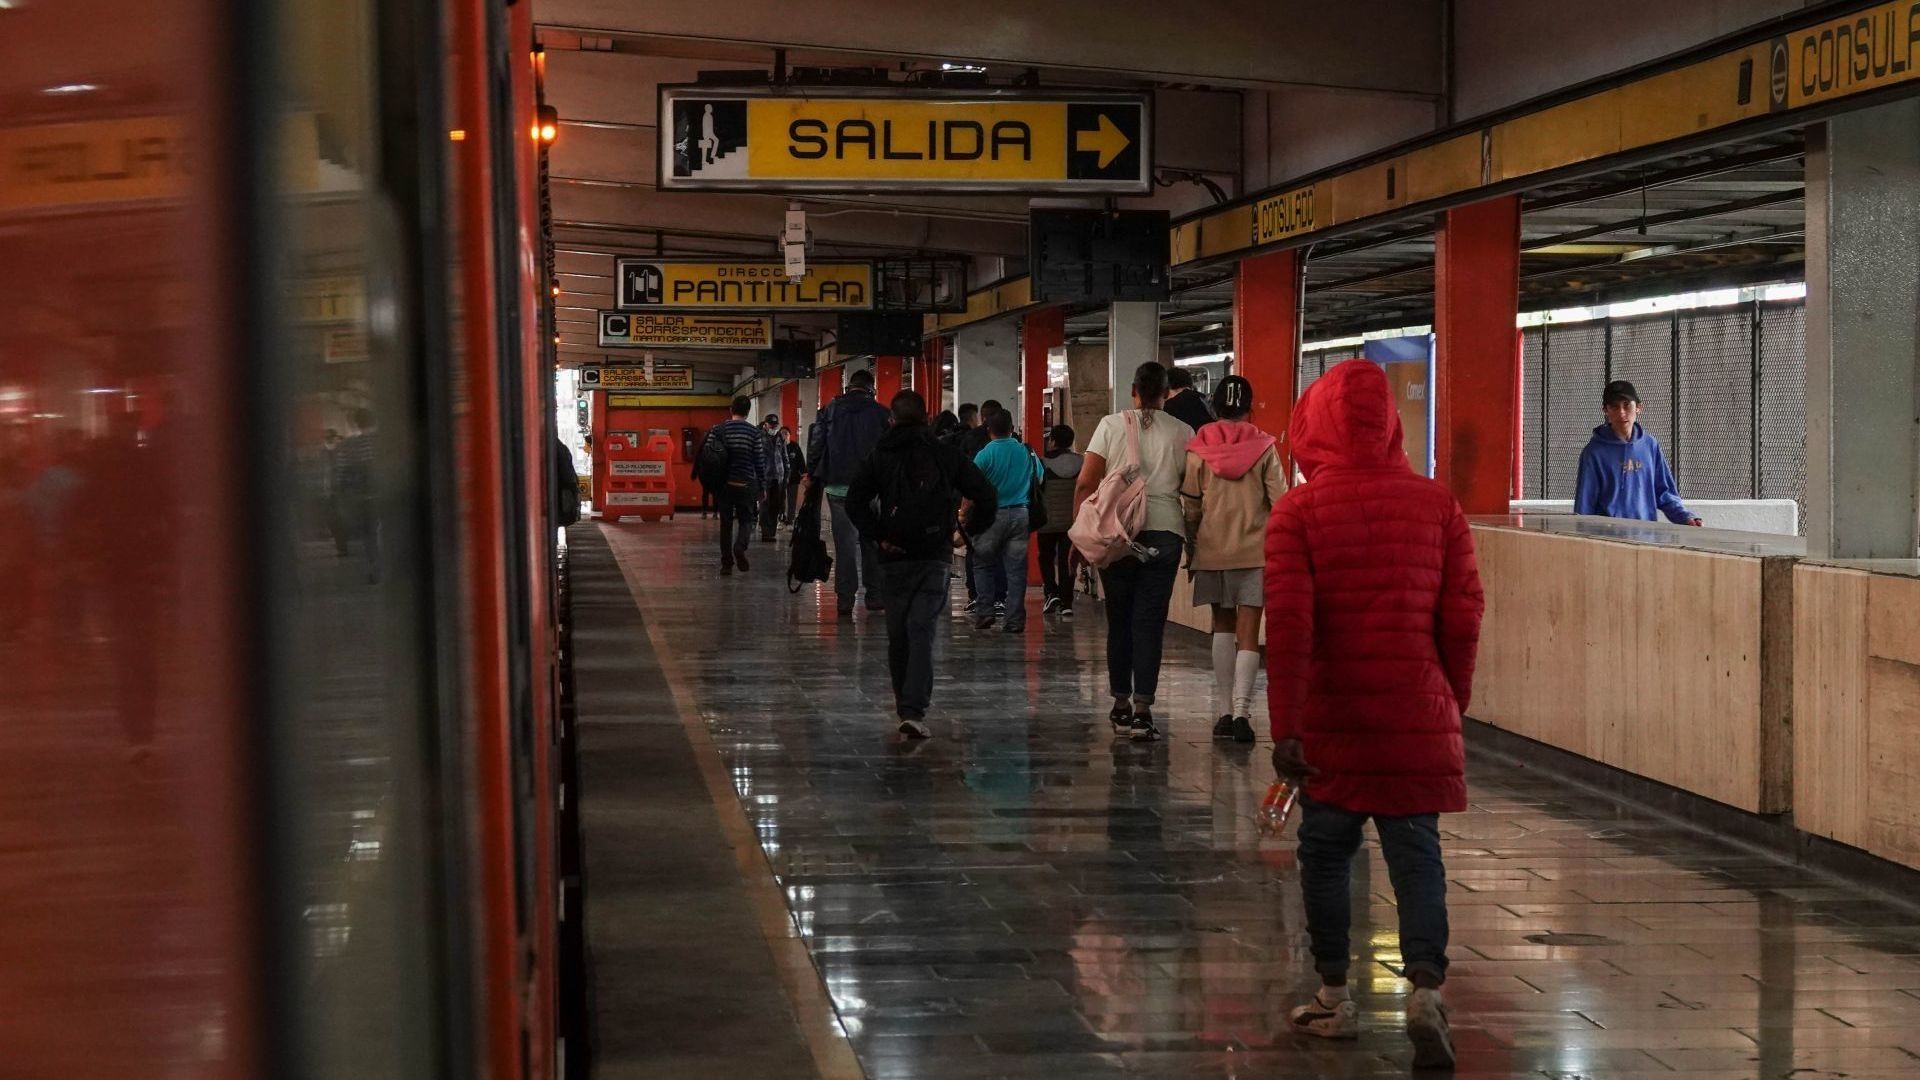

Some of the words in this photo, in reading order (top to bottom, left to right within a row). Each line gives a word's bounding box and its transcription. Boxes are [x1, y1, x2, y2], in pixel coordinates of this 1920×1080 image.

[788, 119, 1031, 161] SALIDA
[1263, 190, 1314, 238] CONSULADO
[718, 267, 814, 278] DIRECCN
[673, 280, 864, 303] PANTITLAN
[606, 315, 627, 336] C
[636, 316, 684, 326] SALIDA
[635, 325, 764, 337] CORRESPONDENCIA
[583, 369, 599, 383] C
[1406, 381, 1426, 400] Comex
